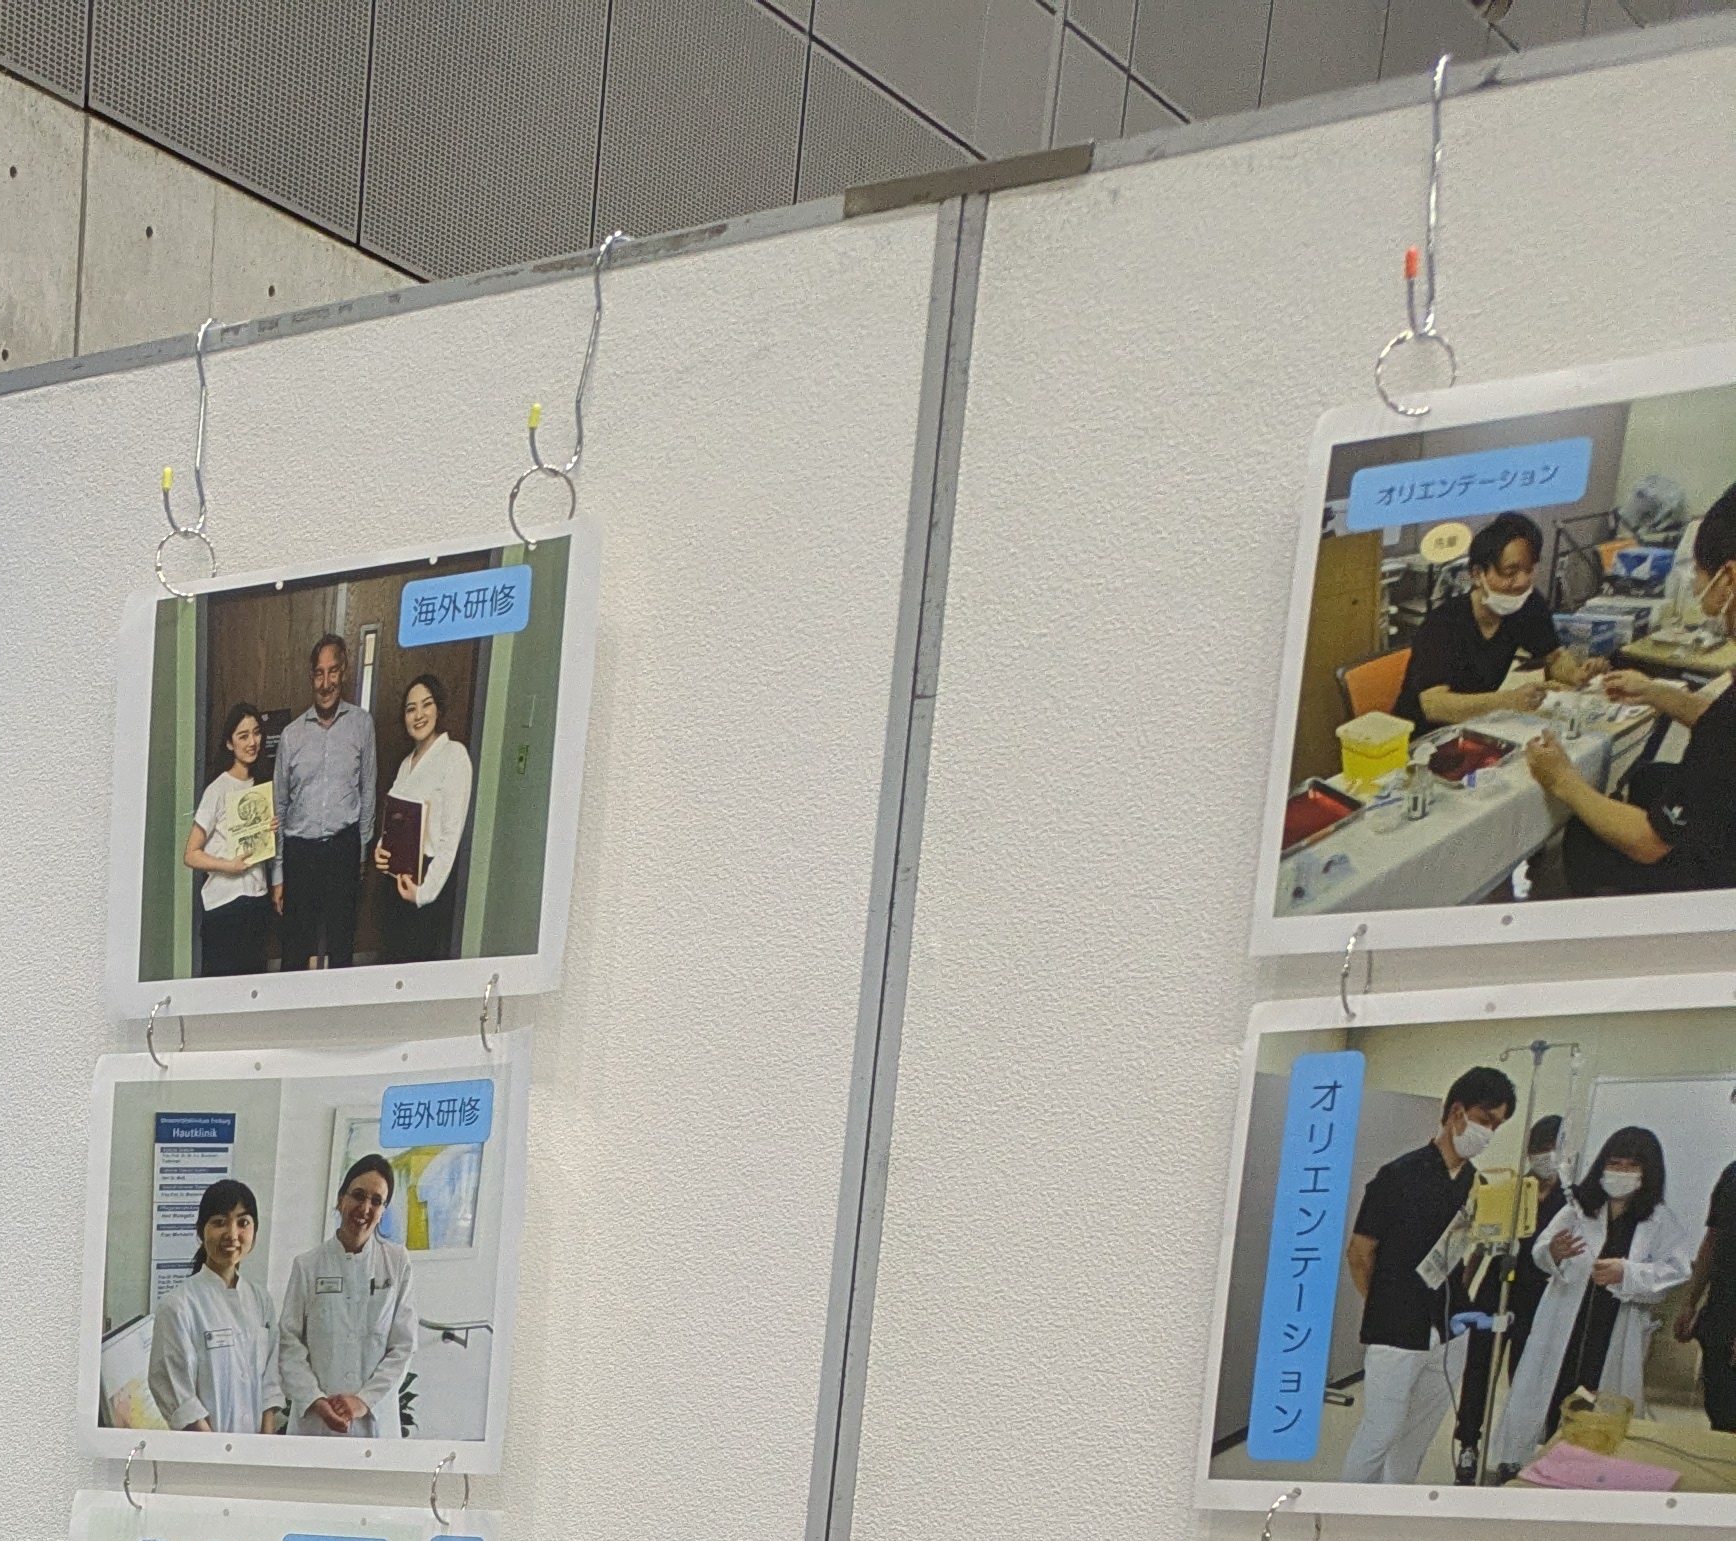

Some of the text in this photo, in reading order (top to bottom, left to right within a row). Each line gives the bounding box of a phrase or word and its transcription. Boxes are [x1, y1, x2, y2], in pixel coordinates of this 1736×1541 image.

[411, 583, 516, 628] 海外研修
[172, 1127, 218, 1138] Hautklinik
[391, 1096, 481, 1130] 海外研修
[1273, 1079, 1344, 1435] オリエンテーション
